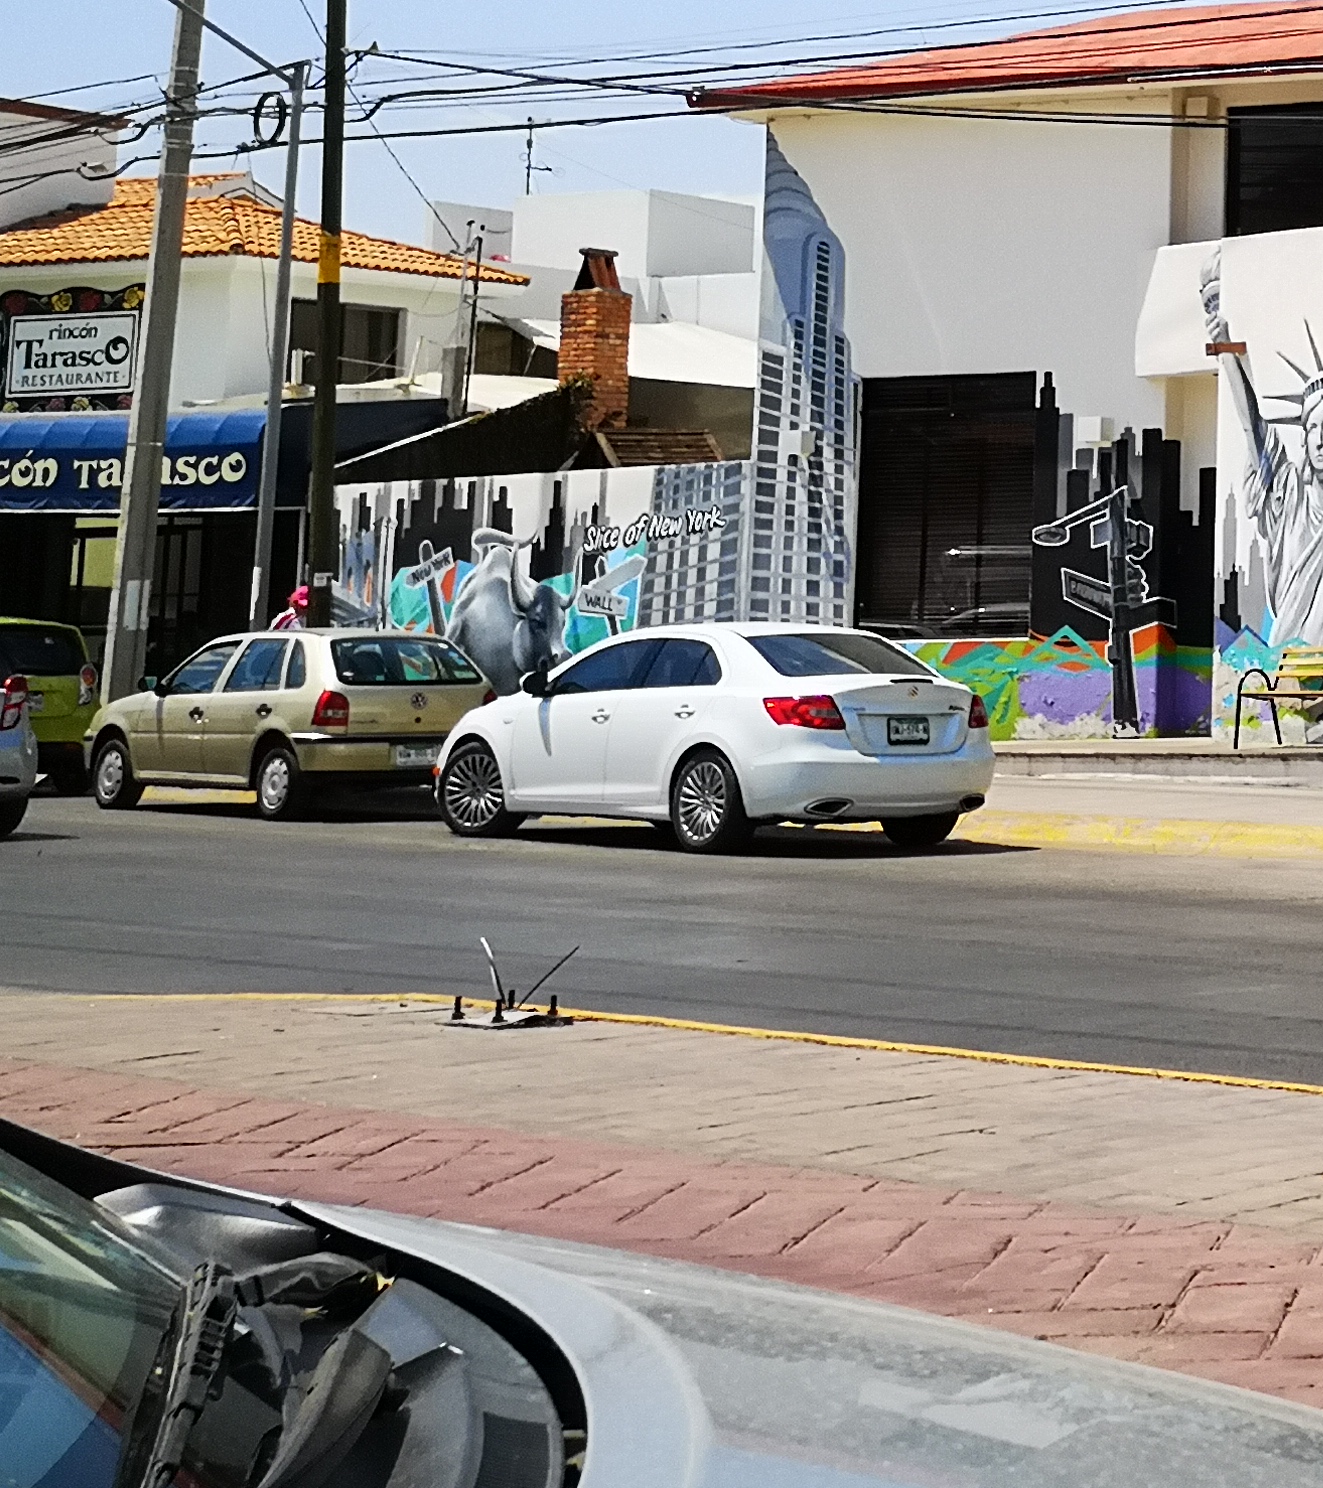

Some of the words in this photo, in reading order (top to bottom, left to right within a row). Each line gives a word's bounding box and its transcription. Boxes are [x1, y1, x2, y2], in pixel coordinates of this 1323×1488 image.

[48, 321, 99, 340] rincón
[20, 370, 120, 388] RESTAURANTE
[583, 525, 620, 552] Slice
[623, 513, 650, 548] of
[647, 512, 683, 542] New
[686, 505, 726, 536] York
